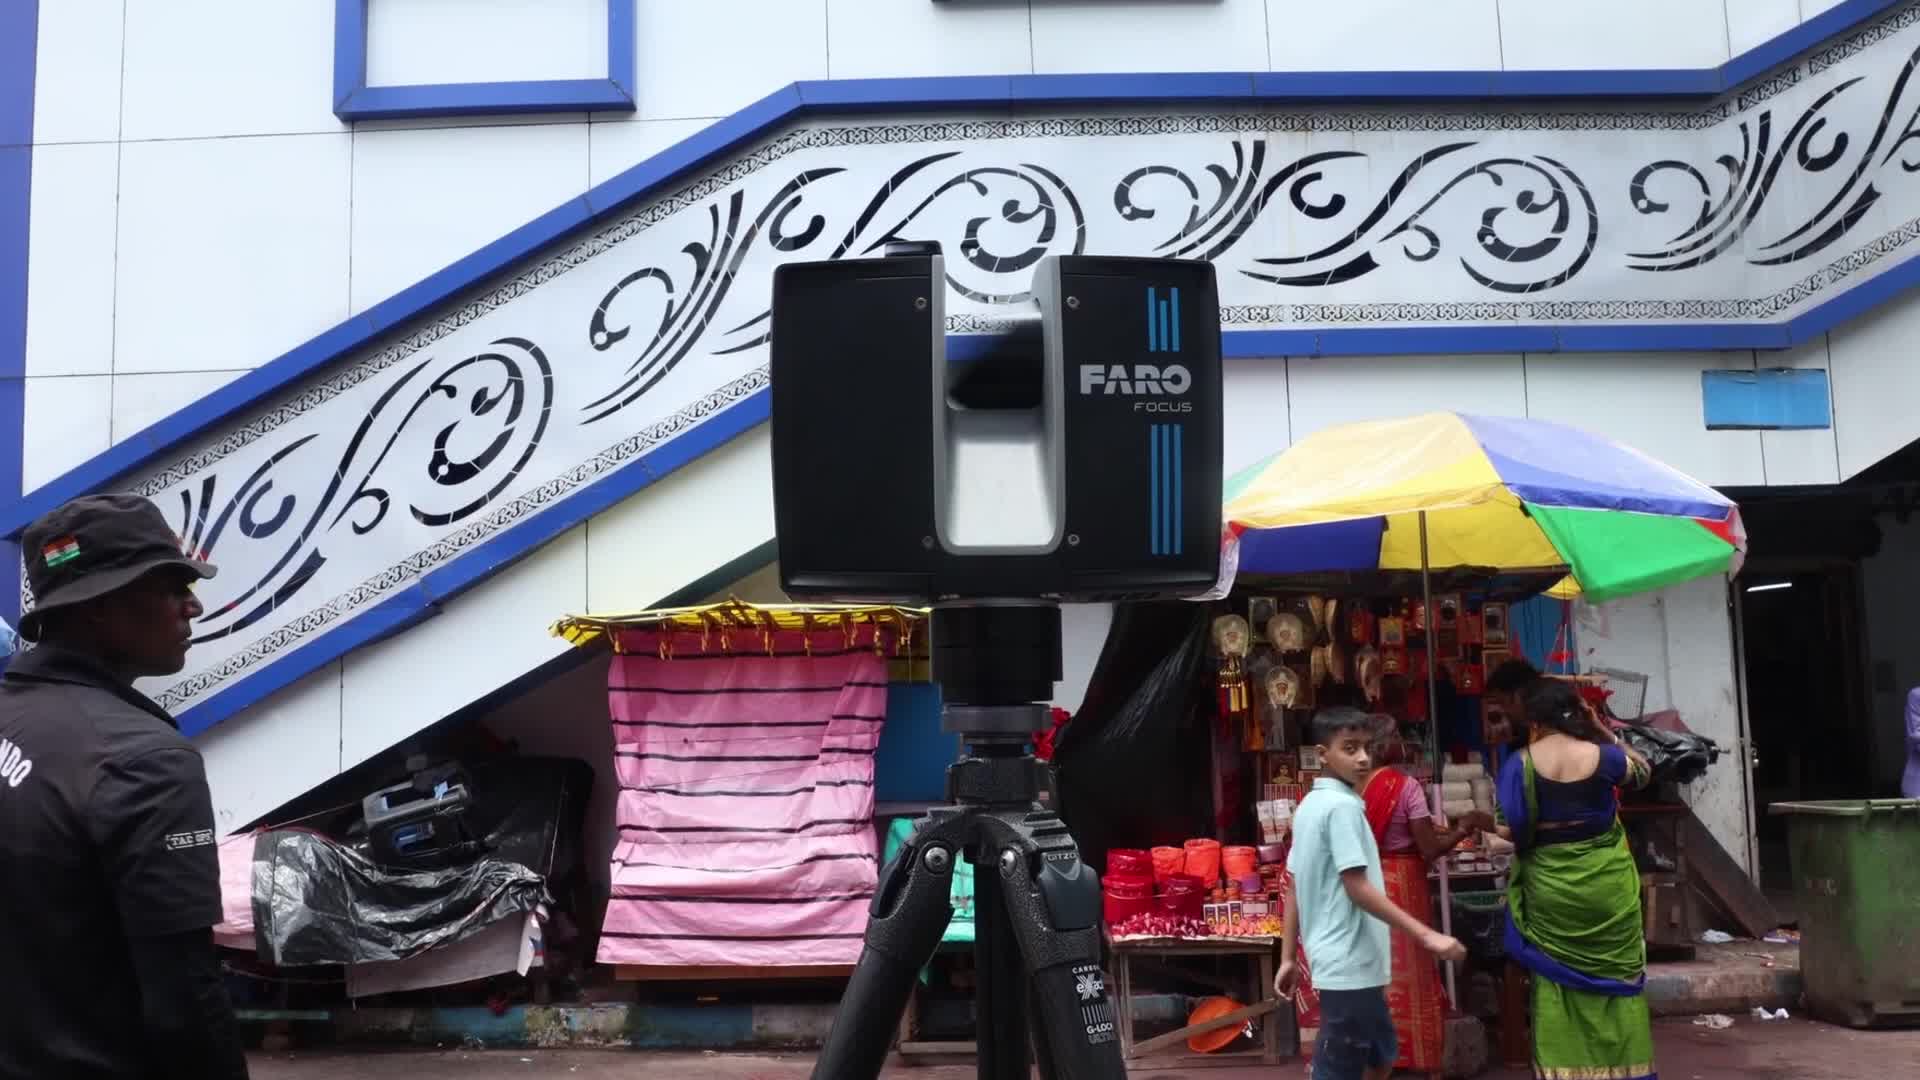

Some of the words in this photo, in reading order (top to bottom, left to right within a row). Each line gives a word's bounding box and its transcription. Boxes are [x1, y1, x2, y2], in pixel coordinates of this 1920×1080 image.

[1080, 364, 1191, 395] FARO
[1133, 402, 1192, 412] FOCUS
[170, 835, 194, 846] TAC
